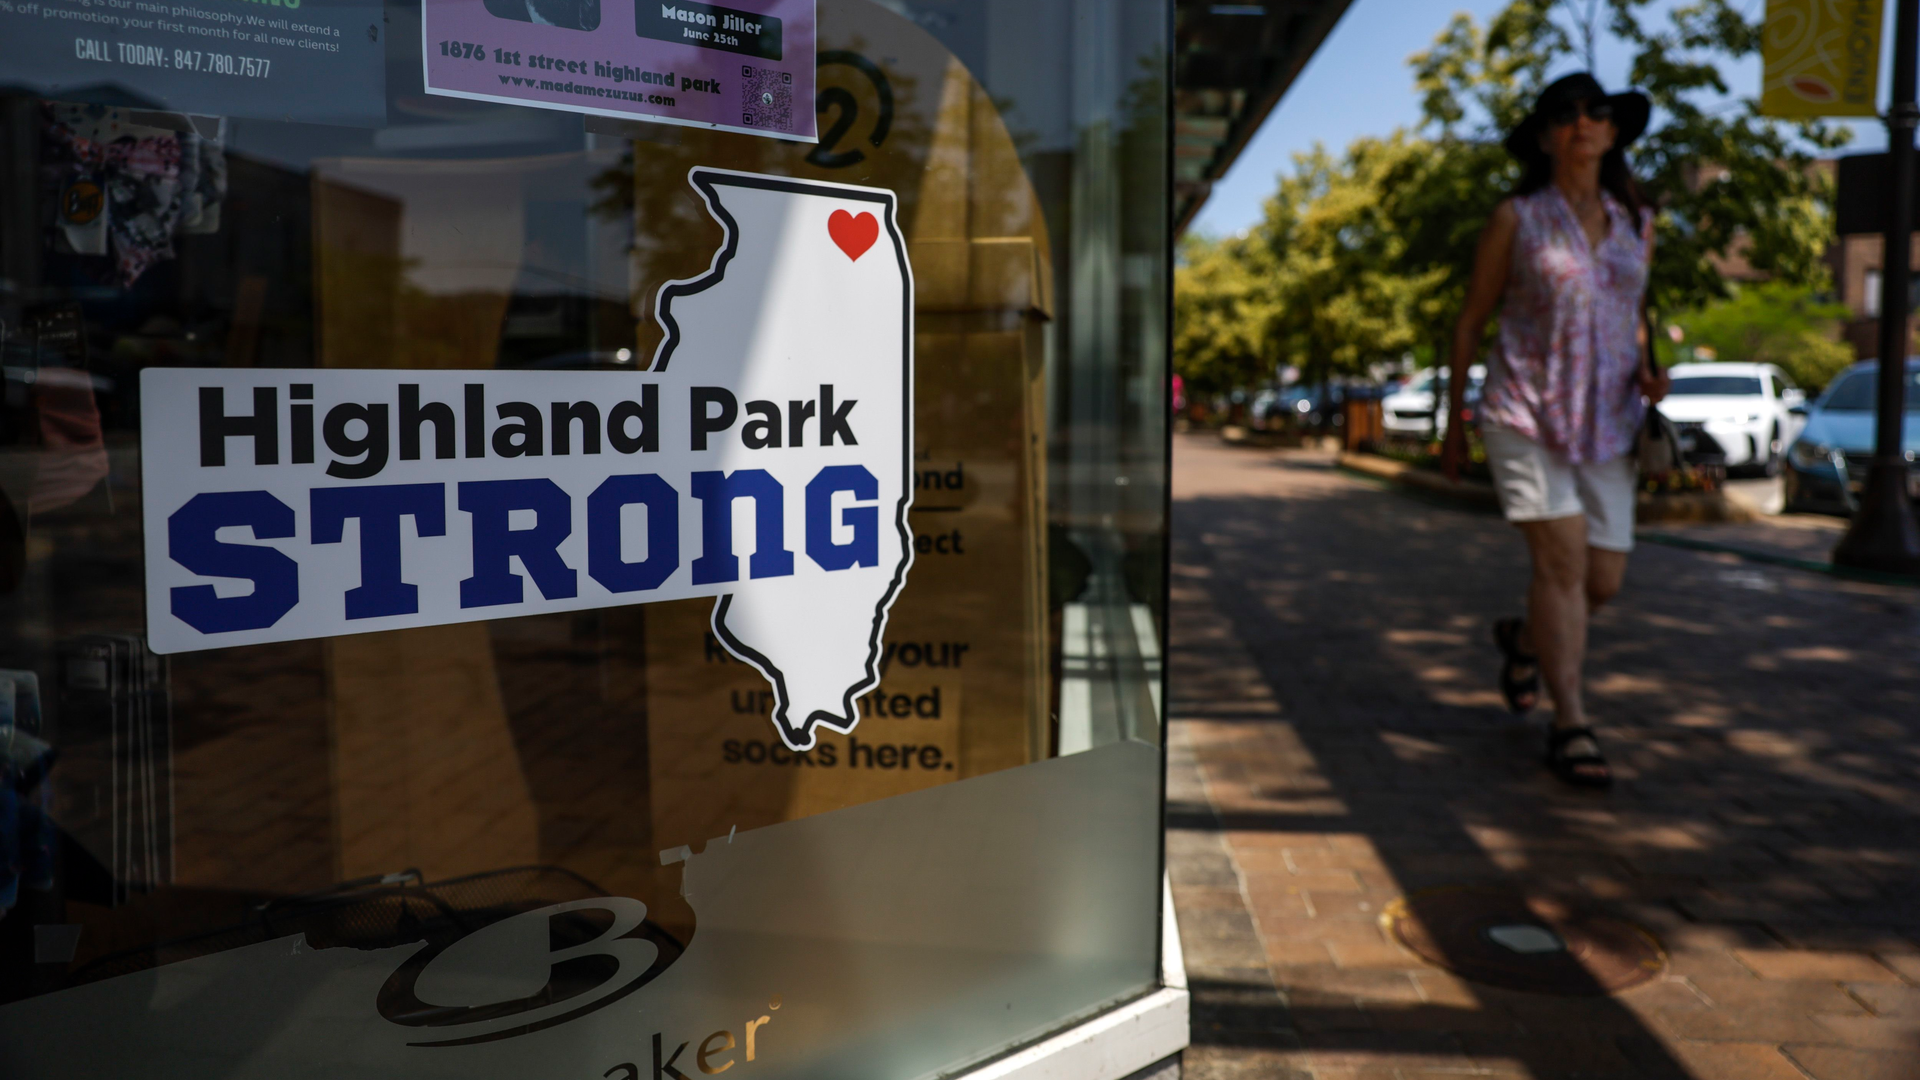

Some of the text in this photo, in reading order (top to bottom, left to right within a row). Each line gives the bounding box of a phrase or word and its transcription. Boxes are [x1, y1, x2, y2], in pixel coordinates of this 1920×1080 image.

[17, 3, 39, 15] off
[43, 7, 119, 25] promotion
[123, 18, 156, 29] your
[157, 19, 185, 33] first
[188, 25, 230, 39] month
[233, 29, 251, 41] for
[254, 33, 268, 44] all
[271, 36, 295, 47] new
[298, 38, 339, 52] clients!
[108, 0, 132, 9] our
[136, 2, 169, 14] main
[268, 19, 288, 30] will
[291, 22, 331, 36] extend
[334, 28, 341, 37] a
[662, 4, 762, 36] Mason Jiller
[683, 27, 738, 46] June 25th
[75, 37, 271, 78] CALL TODAY: 847.780.7577
[439, 40, 721, 95] 1876 1st street highland park
[498, 74, 676, 107] www.madamezuzus.com
[198, 383, 859, 480] Highland Park
[849, 735, 954, 771] here.
